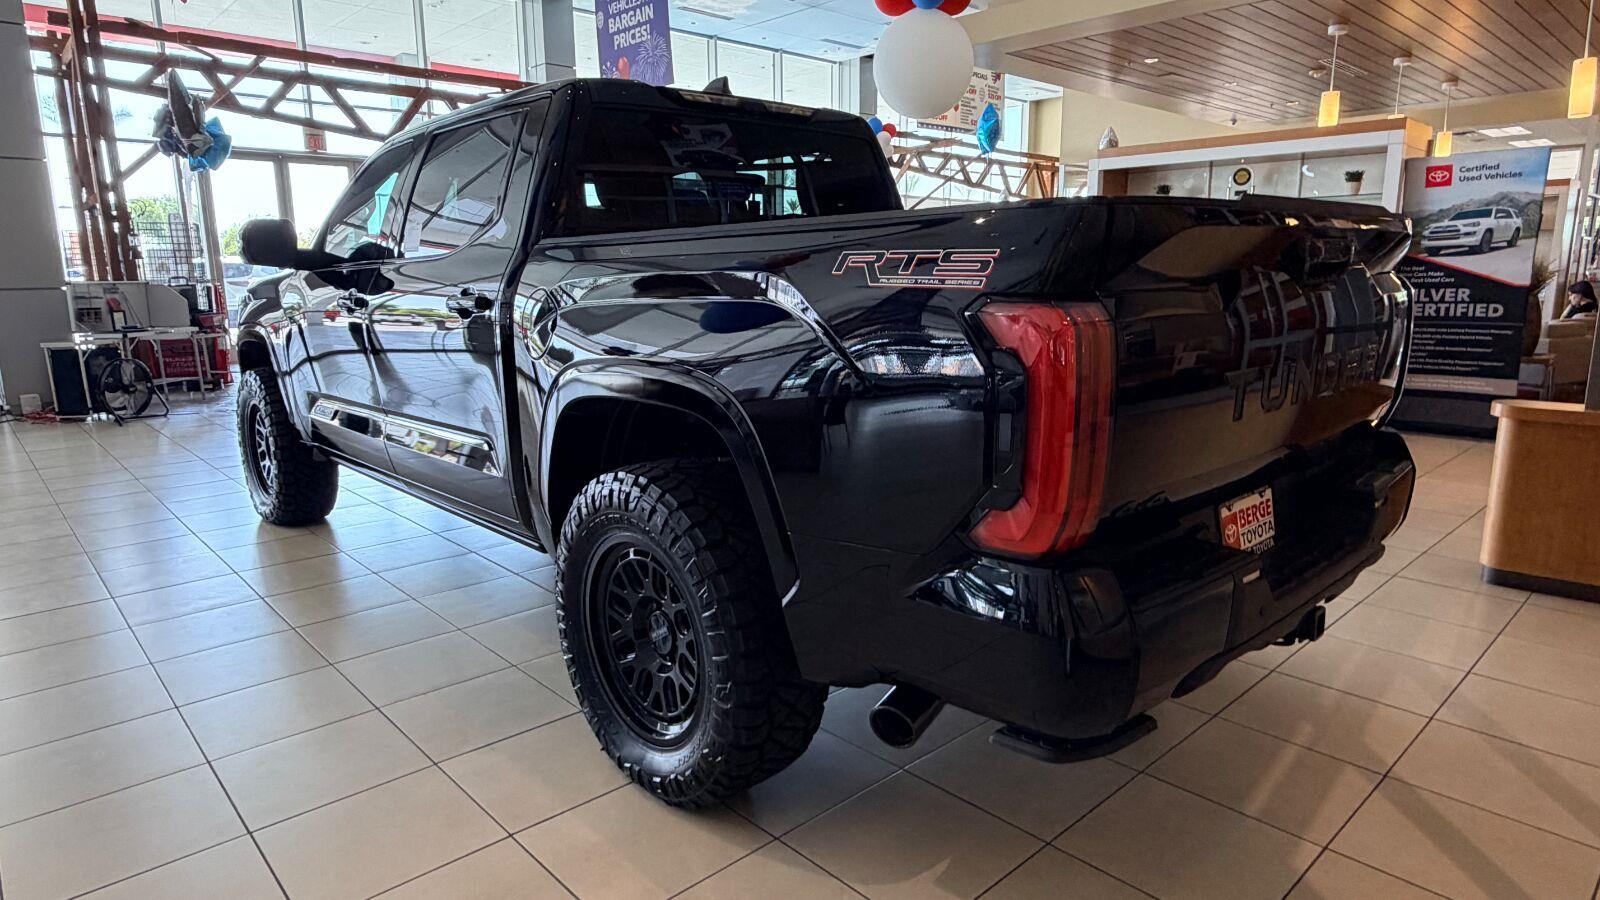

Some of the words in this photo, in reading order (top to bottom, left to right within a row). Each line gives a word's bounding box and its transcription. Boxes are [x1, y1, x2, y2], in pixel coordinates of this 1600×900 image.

[608, 4, 654, 33] BARGAIN
[614, 24, 651, 50] PRICES!
[1459, 163, 1500, 173] Certified
[1459, 174, 1482, 182] Used
[1484, 171, 1523, 180] Vehicles
[831, 248, 1001, 281] RTS
[1414, 288, 1471, 301] ILVER
[1414, 303, 1504, 317] ERTIFIED
[1239, 498, 1272, 530] BERGE
[1241, 520, 1274, 546] TOYOTA
